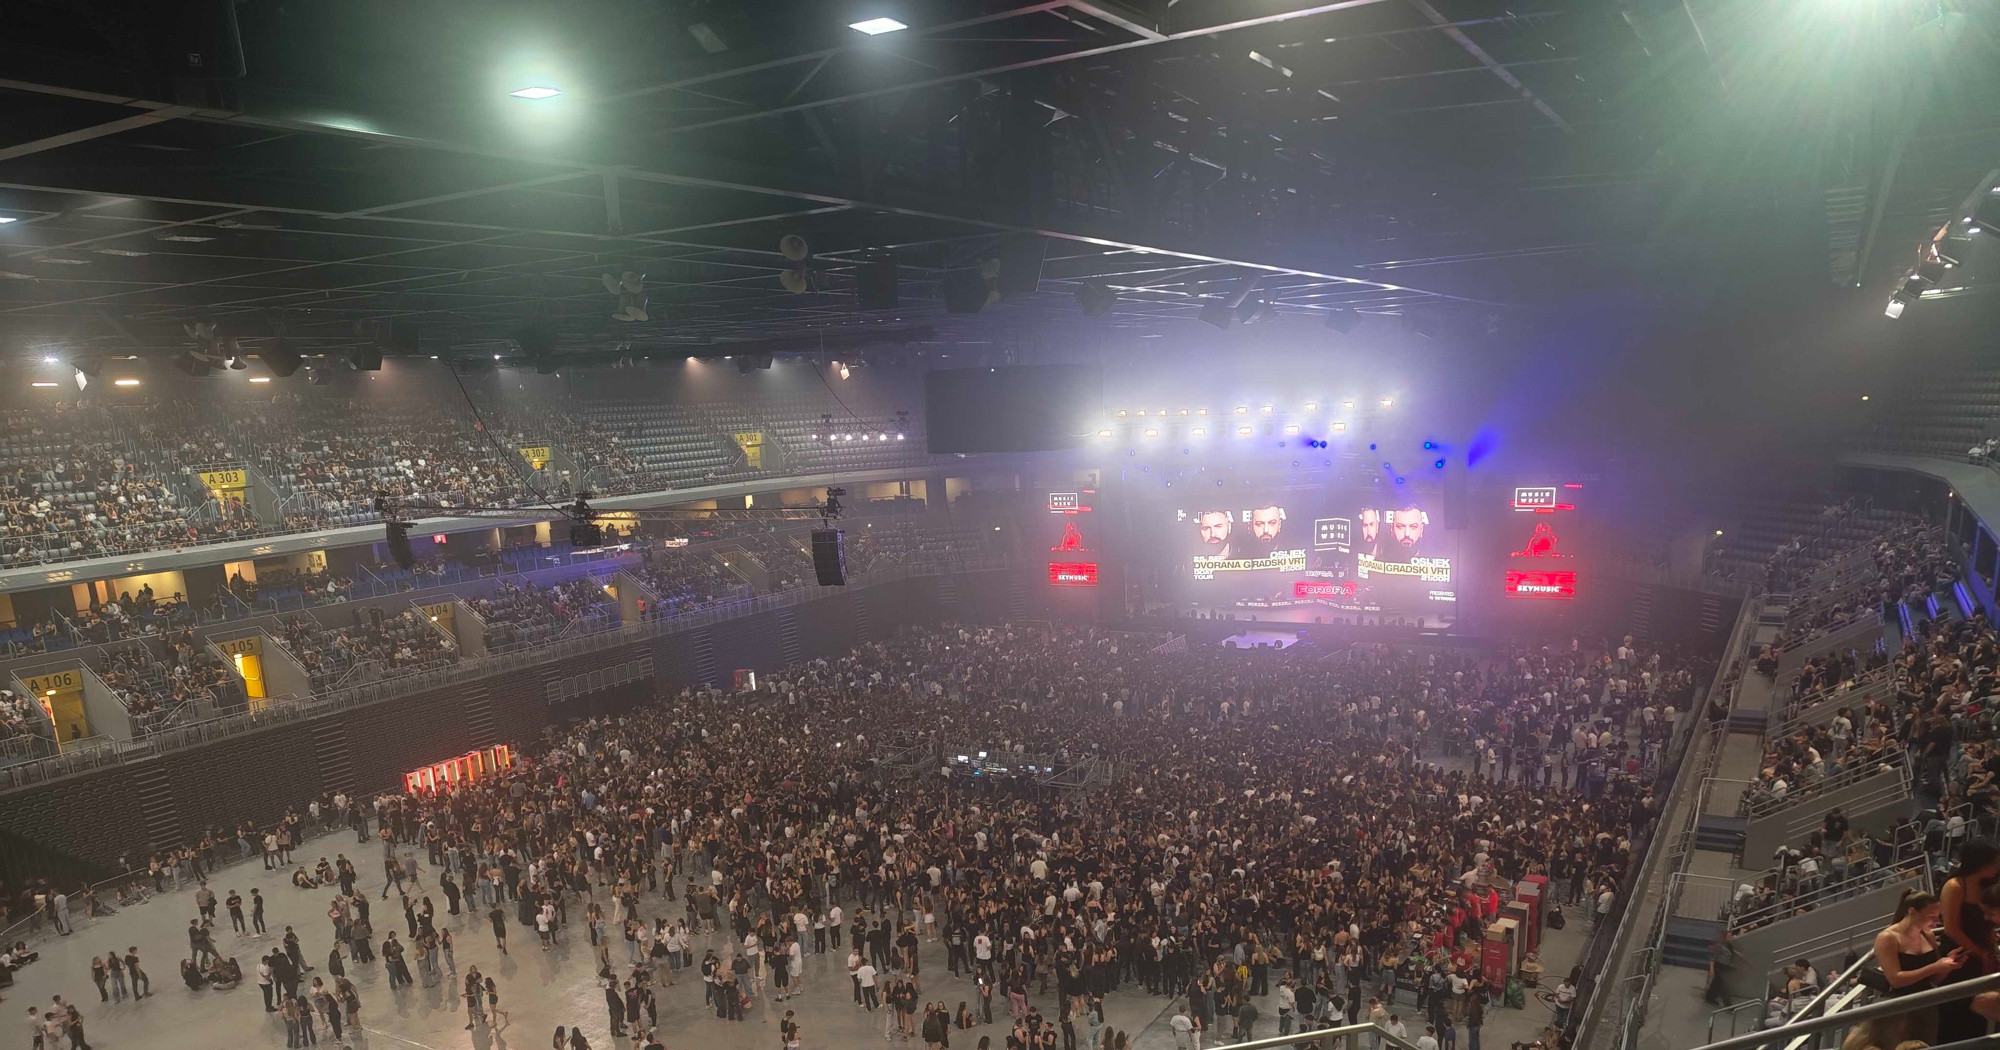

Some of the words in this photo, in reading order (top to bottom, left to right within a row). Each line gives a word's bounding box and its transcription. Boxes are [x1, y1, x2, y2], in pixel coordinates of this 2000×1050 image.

[532, 448, 545, 457] 302
[208, 474, 216, 484] A
[219, 471, 239, 483] 303
[1270, 549, 1306, 559] OSIJEK
[1194, 560, 1241, 569] DVORANA
[1244, 559, 1286, 569] GRADSKI
[1289, 557, 1305, 566] VRT
[1410, 557, 1450, 567] OSIJEK
[1386, 564, 1428, 574] GRADSKI
[1430, 567, 1450, 575] VRT
[430, 604, 448, 615] 104
[220, 644, 228, 655] A
[231, 640, 254, 653] 105
[30, 679, 40, 692] A
[43, 673, 72, 689] 106
